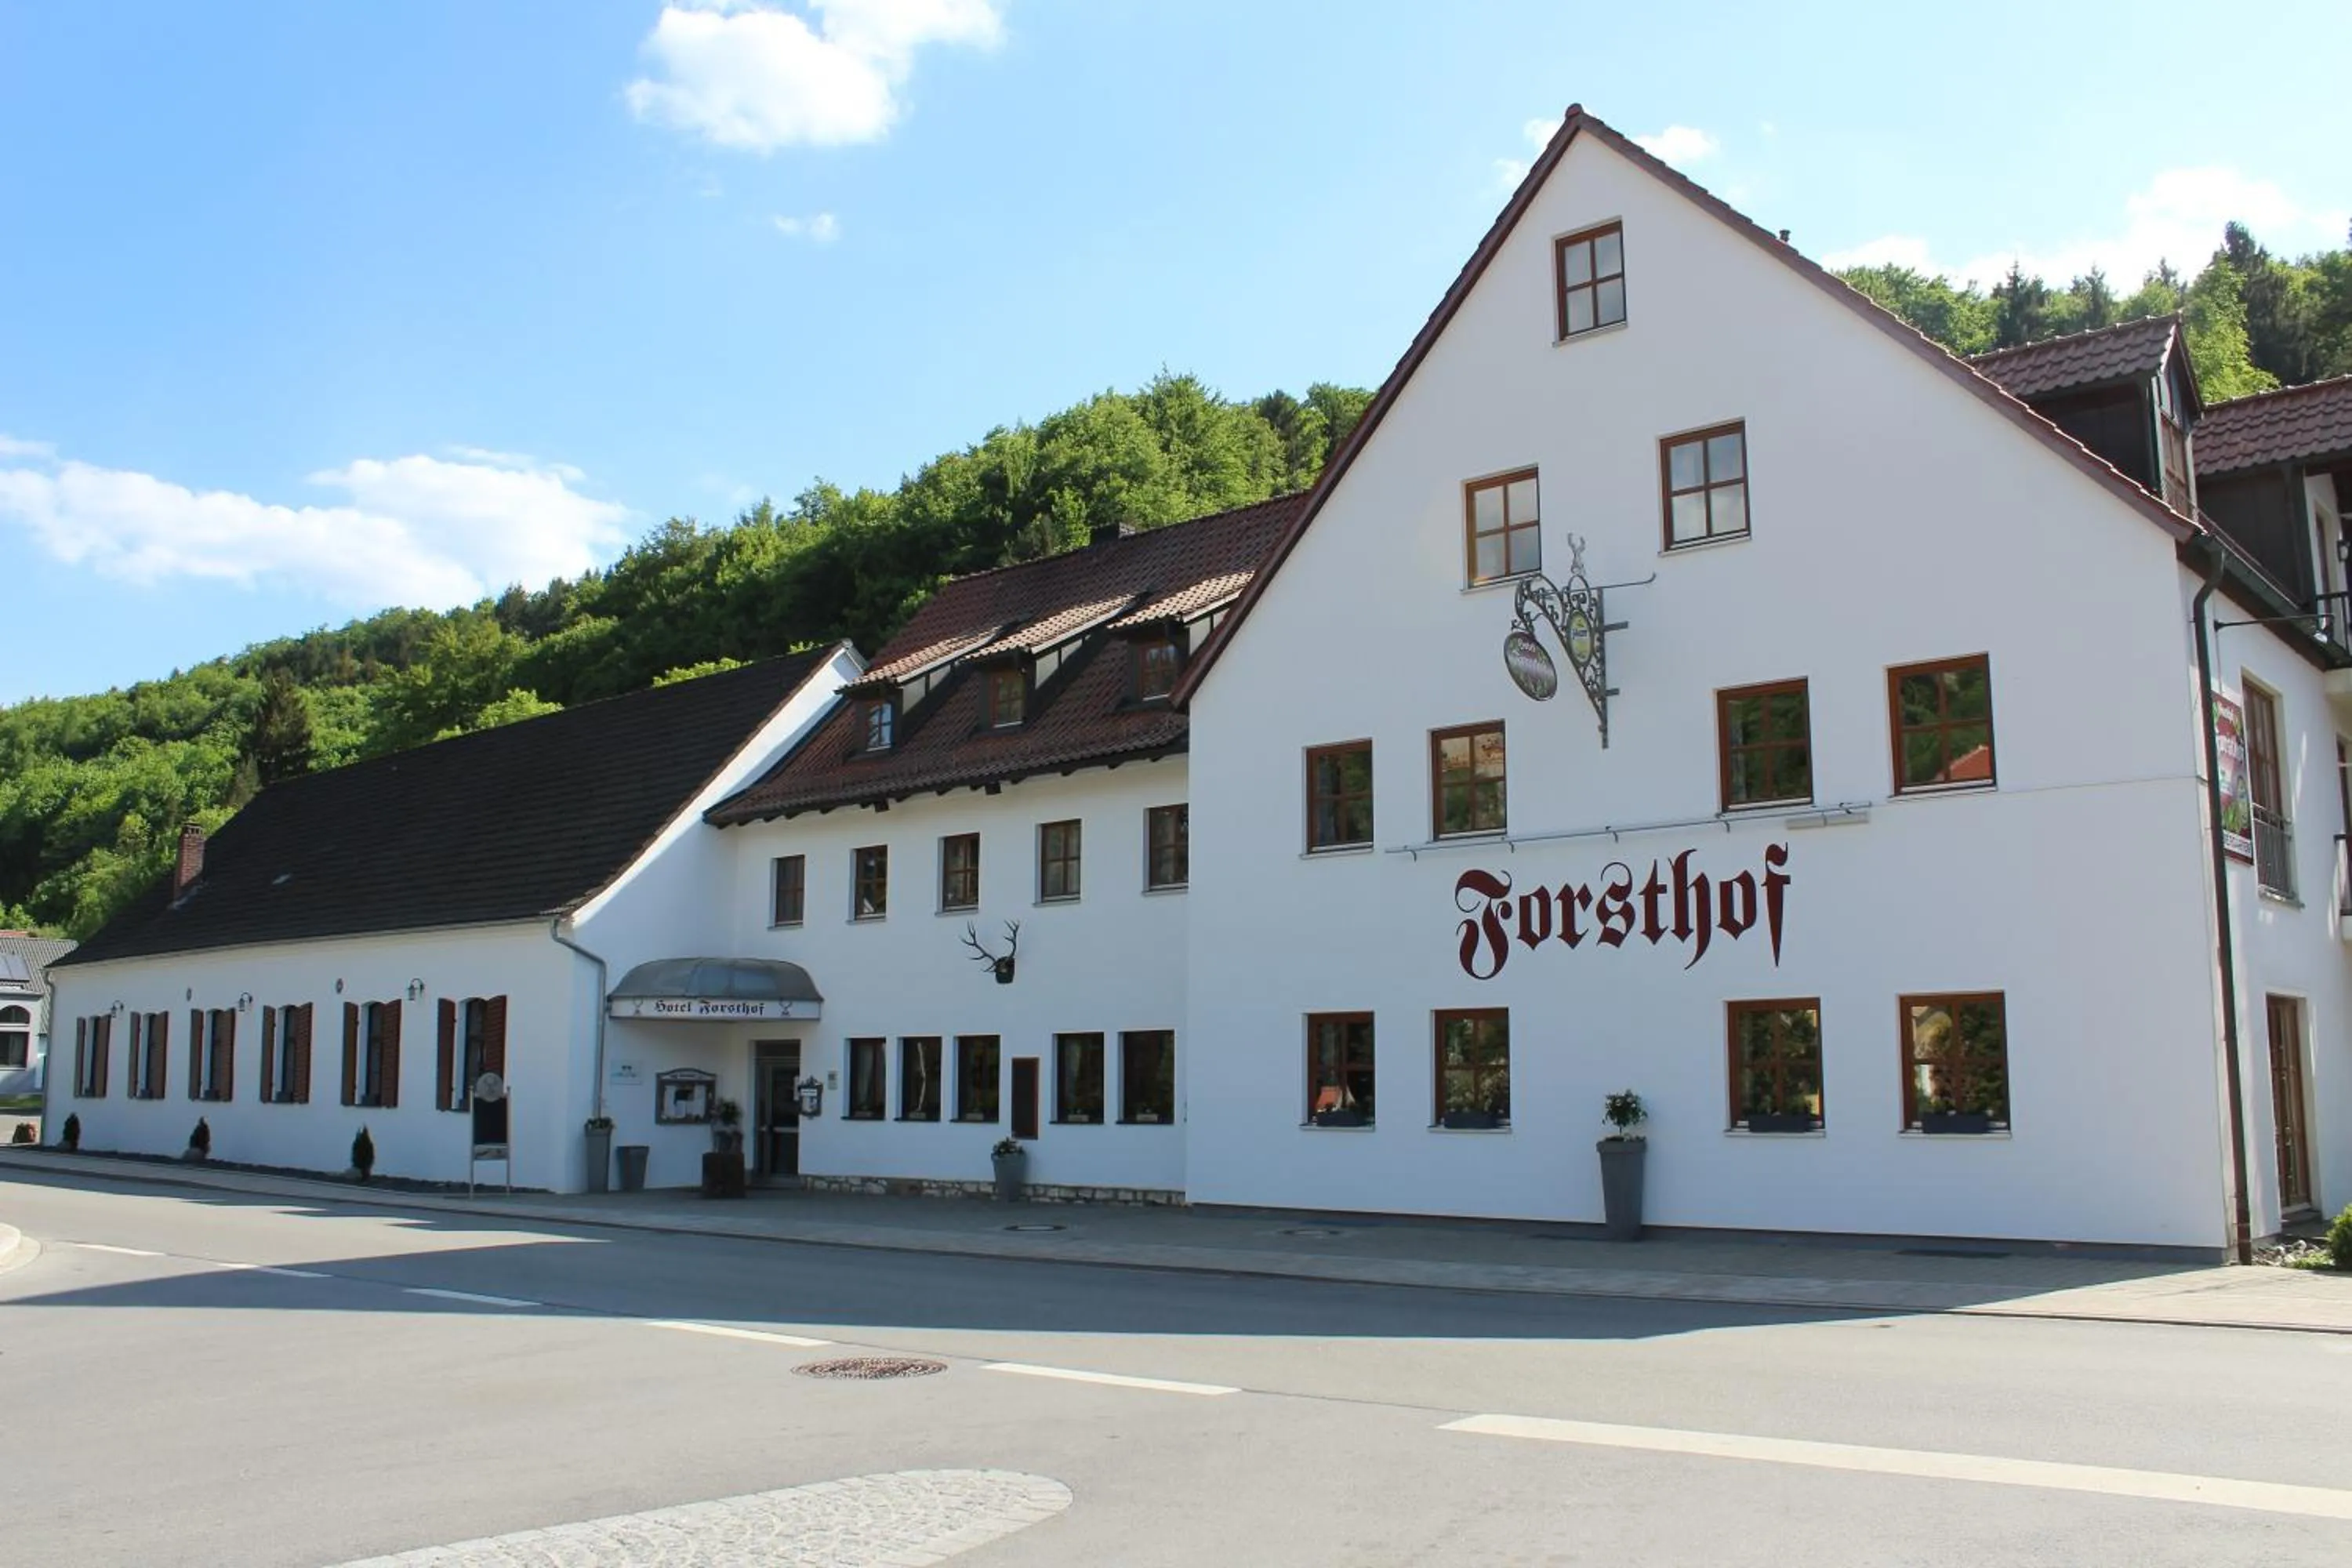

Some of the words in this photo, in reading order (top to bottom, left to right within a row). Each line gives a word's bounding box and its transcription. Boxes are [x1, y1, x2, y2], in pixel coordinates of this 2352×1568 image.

[1455, 842, 1791, 980] Forsthof
[655, 1000, 691, 1013] Hotel
[699, 998, 766, 1016] Forsthof
